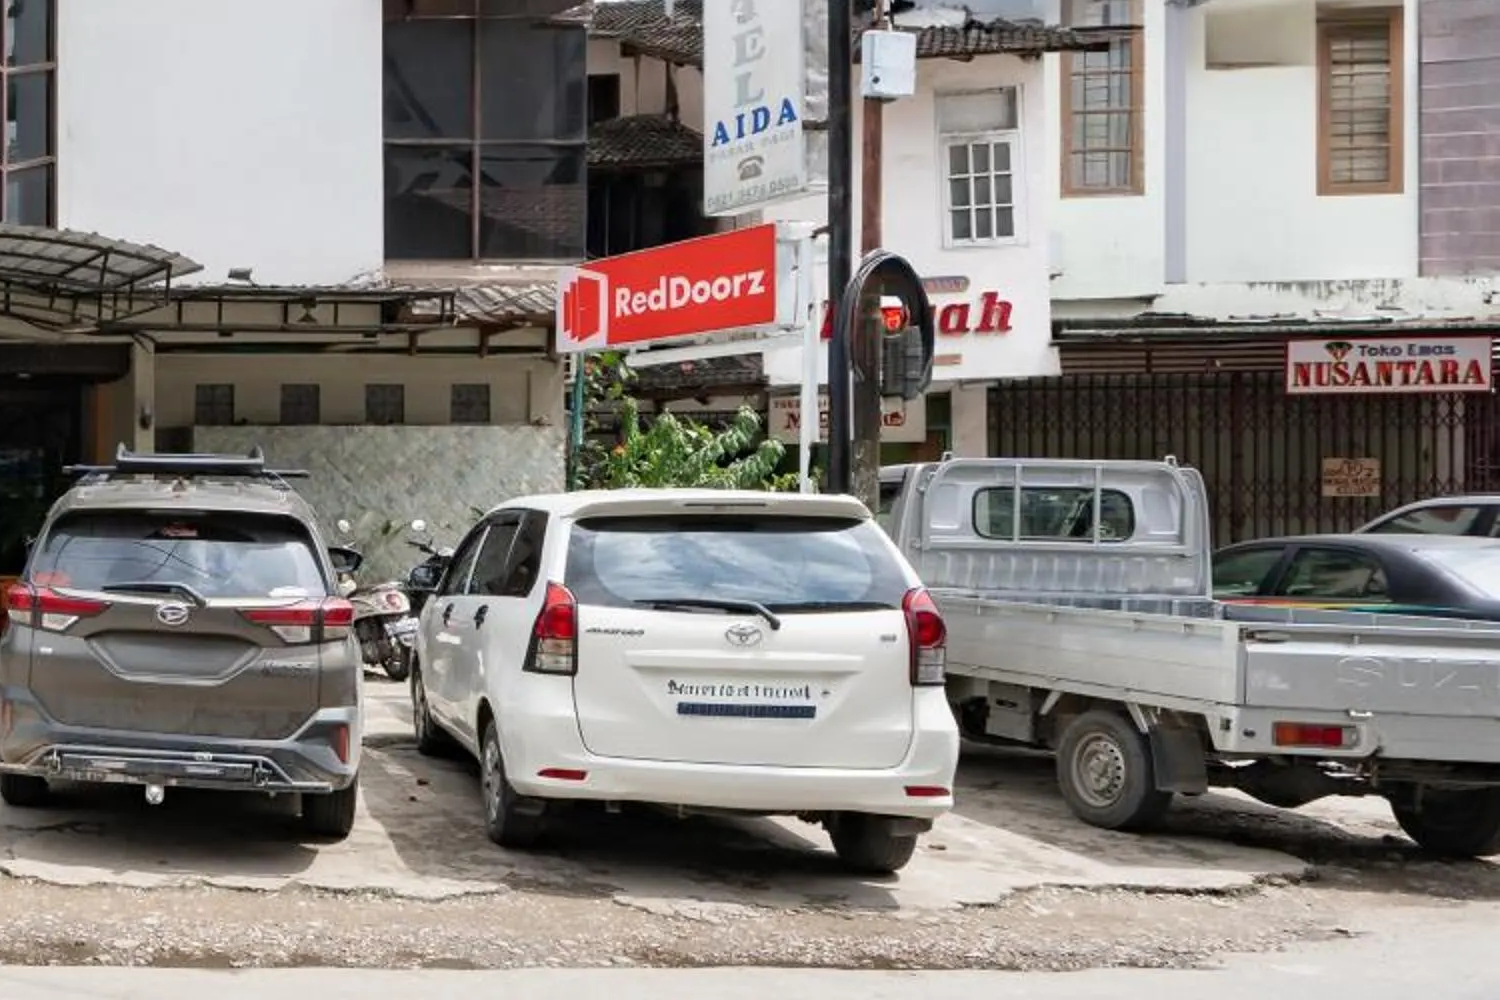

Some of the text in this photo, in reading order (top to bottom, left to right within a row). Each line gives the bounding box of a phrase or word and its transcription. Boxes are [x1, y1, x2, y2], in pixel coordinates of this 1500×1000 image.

[711, 96, 798, 147] AIDA
[614, 269, 766, 319] RedDoorz
[1357, 344, 1403, 358] Toko
[1292, 359, 1486, 388] NUSANTARA
